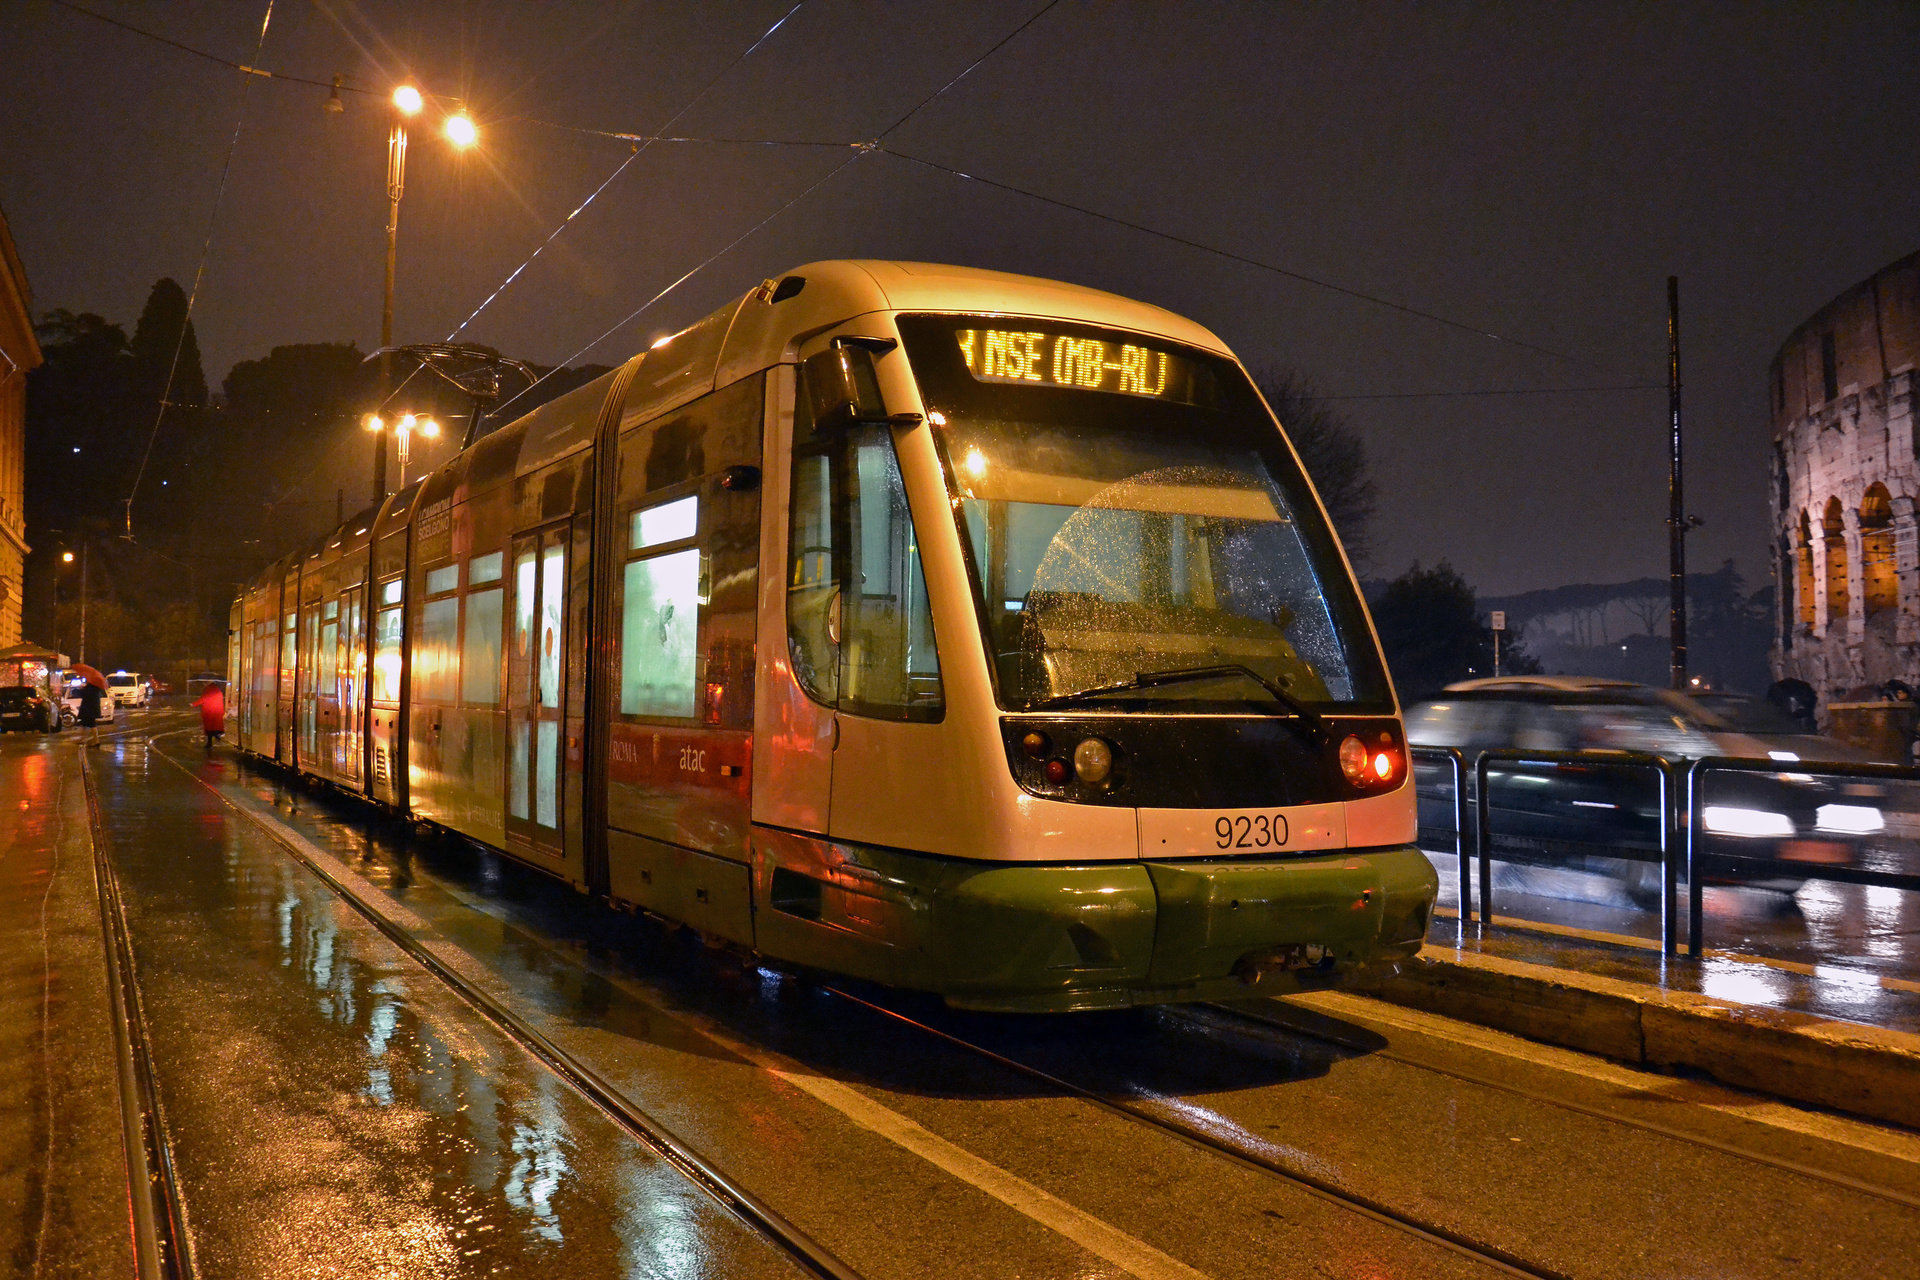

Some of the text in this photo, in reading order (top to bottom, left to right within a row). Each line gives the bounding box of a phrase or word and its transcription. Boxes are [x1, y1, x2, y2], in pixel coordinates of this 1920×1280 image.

[984, 329, 1044, 381] NSE
[679, 744, 706, 773] atac
[1215, 814, 1289, 849] 9230
